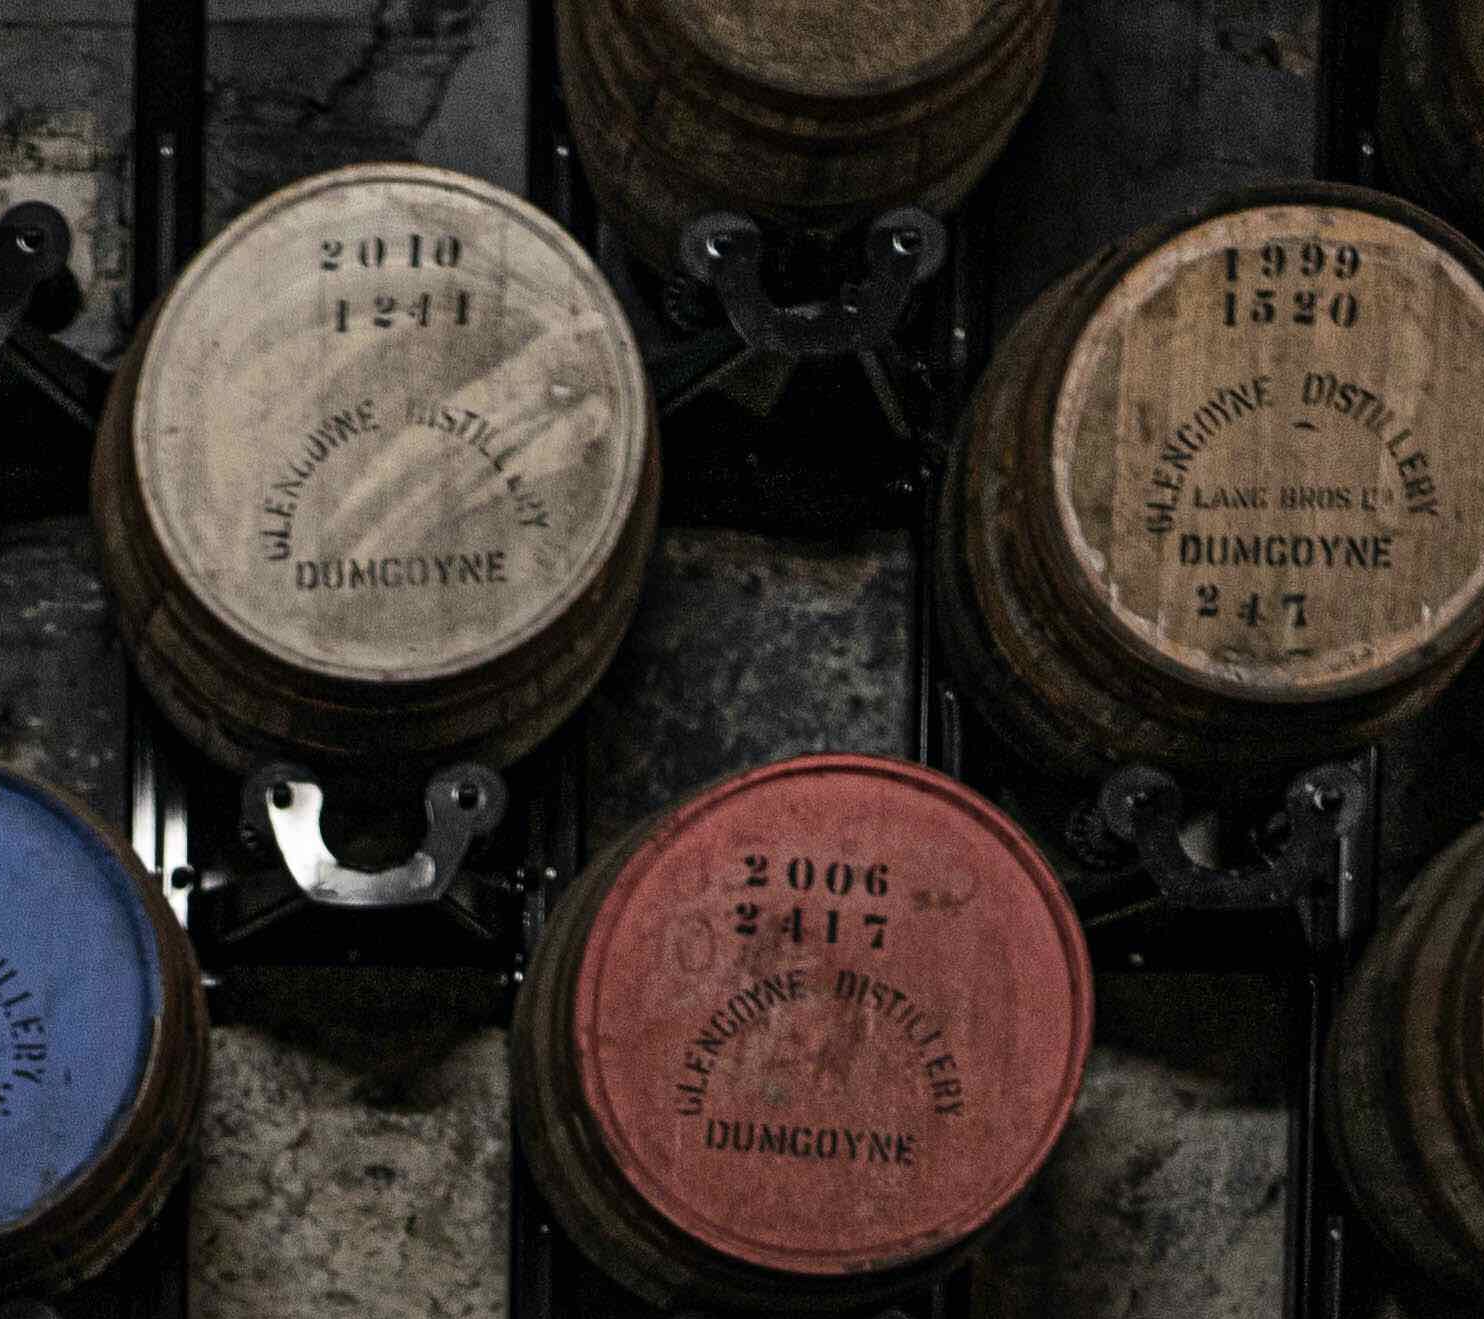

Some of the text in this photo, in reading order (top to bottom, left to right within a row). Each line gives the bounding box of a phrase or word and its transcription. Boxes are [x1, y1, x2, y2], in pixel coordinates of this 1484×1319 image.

[1222, 243, 1362, 283] 1999
[1222, 288, 1359, 328] 1520
[1145, 370, 1438, 535] GLENGOYNE DISTILLERY
[260, 400, 381, 563] GLENGOYNE
[1192, 485, 1353, 511] LANG BROS
[294, 549, 508, 592] DUMGOYNE
[1178, 533, 1394, 570] DUMGOYNE
[1197, 583, 1309, 629] 247
[744, 853, 891, 898] 2006
[735, 900, 890, 951] 2417
[677, 968, 966, 1118] GLENGOYNE DISTILLERY
[703, 1118, 918, 1168] DUMGOYNE
